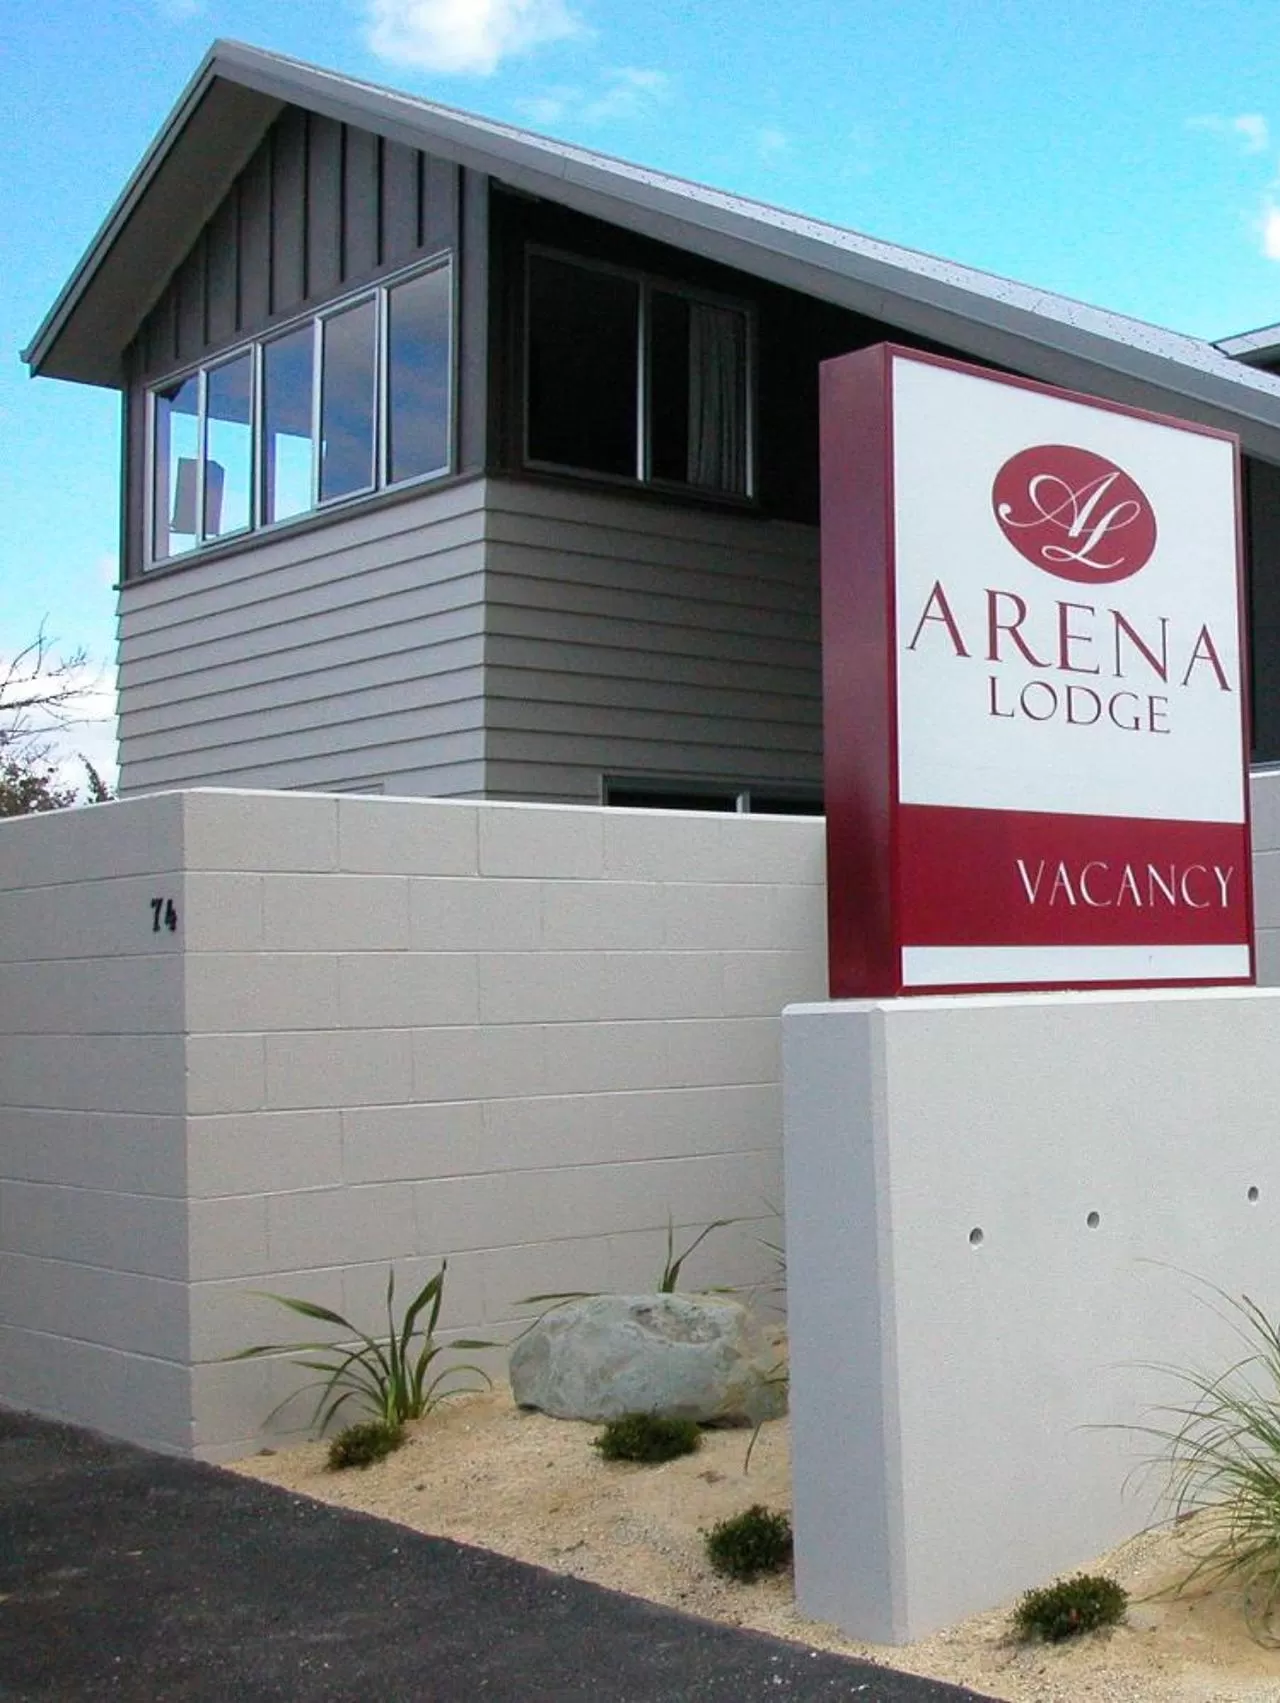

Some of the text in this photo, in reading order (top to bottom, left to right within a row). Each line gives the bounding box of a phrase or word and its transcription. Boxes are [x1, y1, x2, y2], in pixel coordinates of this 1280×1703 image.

[906, 580, 1232, 692] ARENA
[988, 676, 1171, 734] LODGE
[1017, 859, 1234, 909] VACANCY
[150, 898, 177, 932] 74
